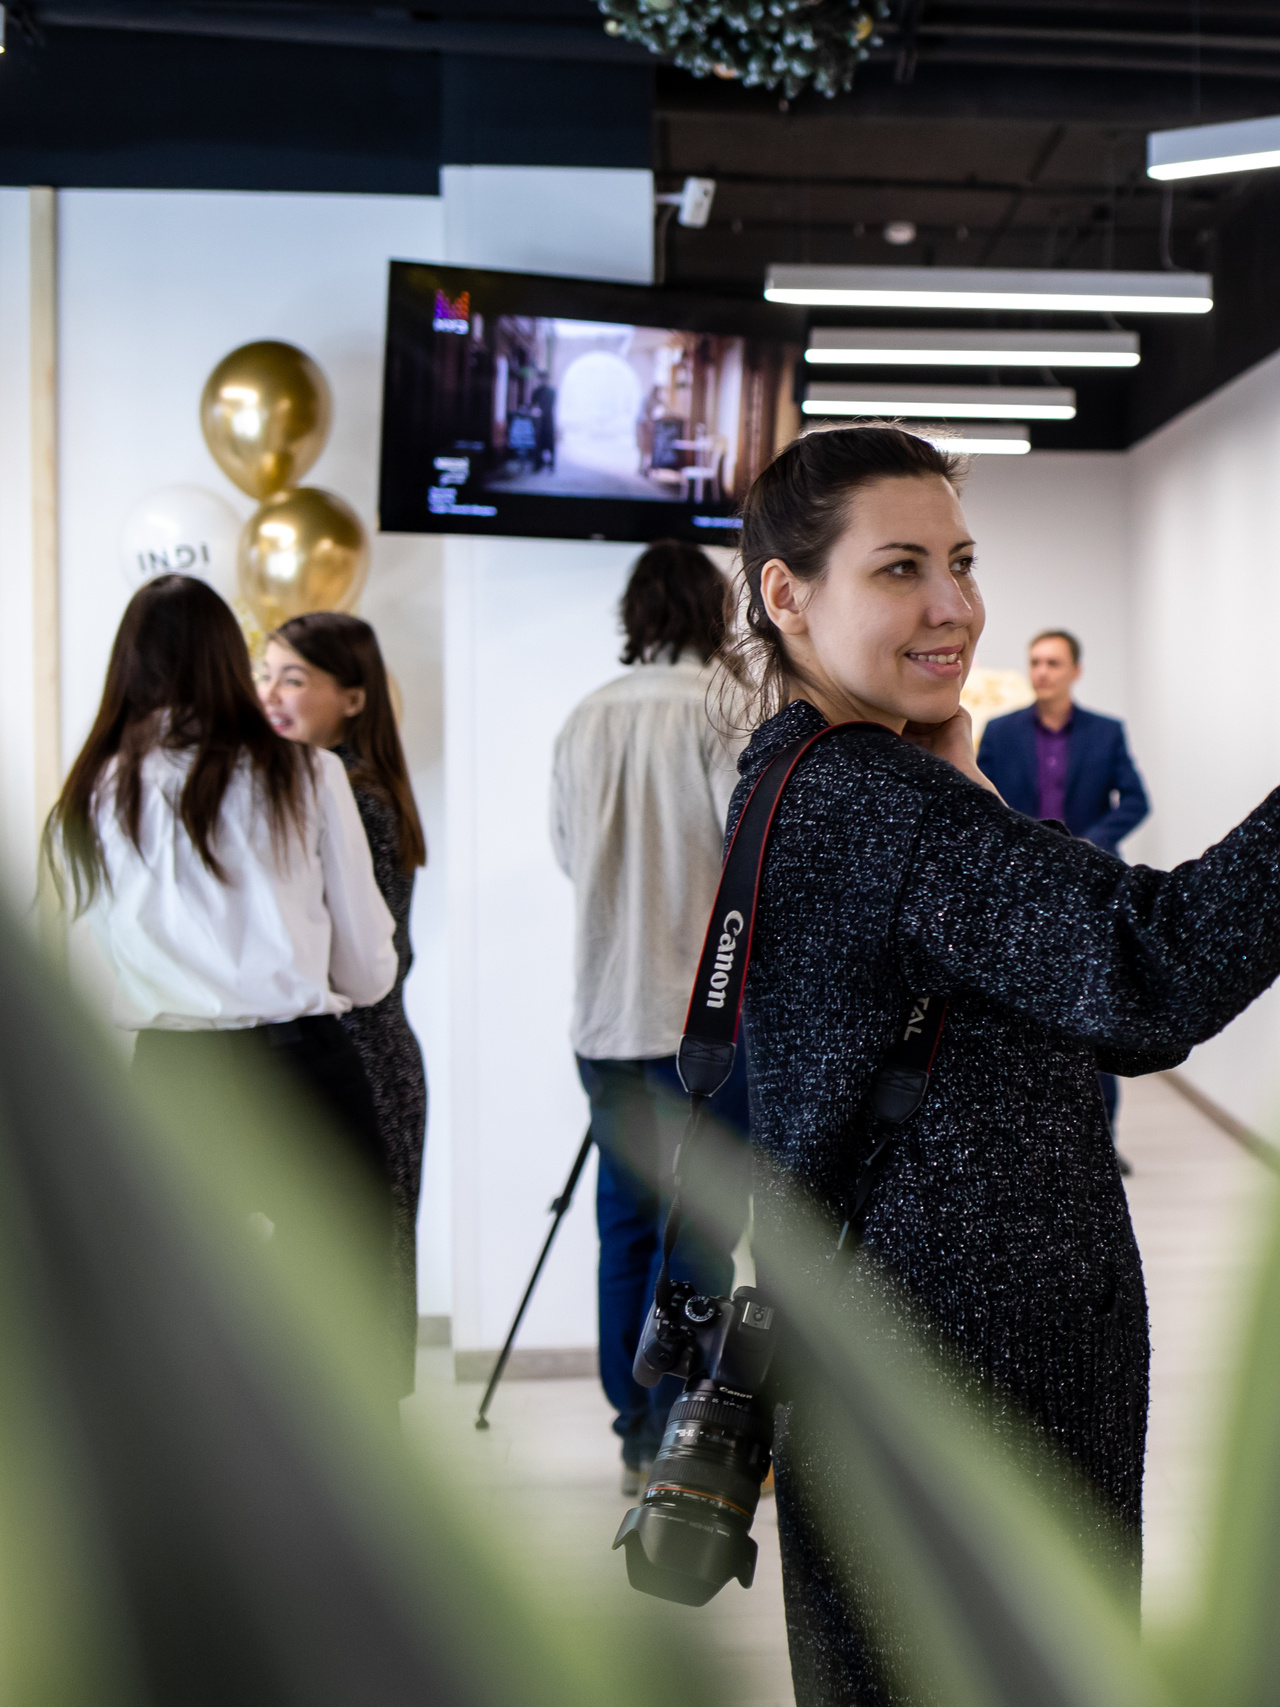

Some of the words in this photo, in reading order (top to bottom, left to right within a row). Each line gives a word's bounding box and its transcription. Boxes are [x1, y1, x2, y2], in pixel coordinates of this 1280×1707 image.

[138, 544, 209, 570] INDI
[706, 910, 744, 1008] Canon
[719, 1386, 753, 1399] Canon
